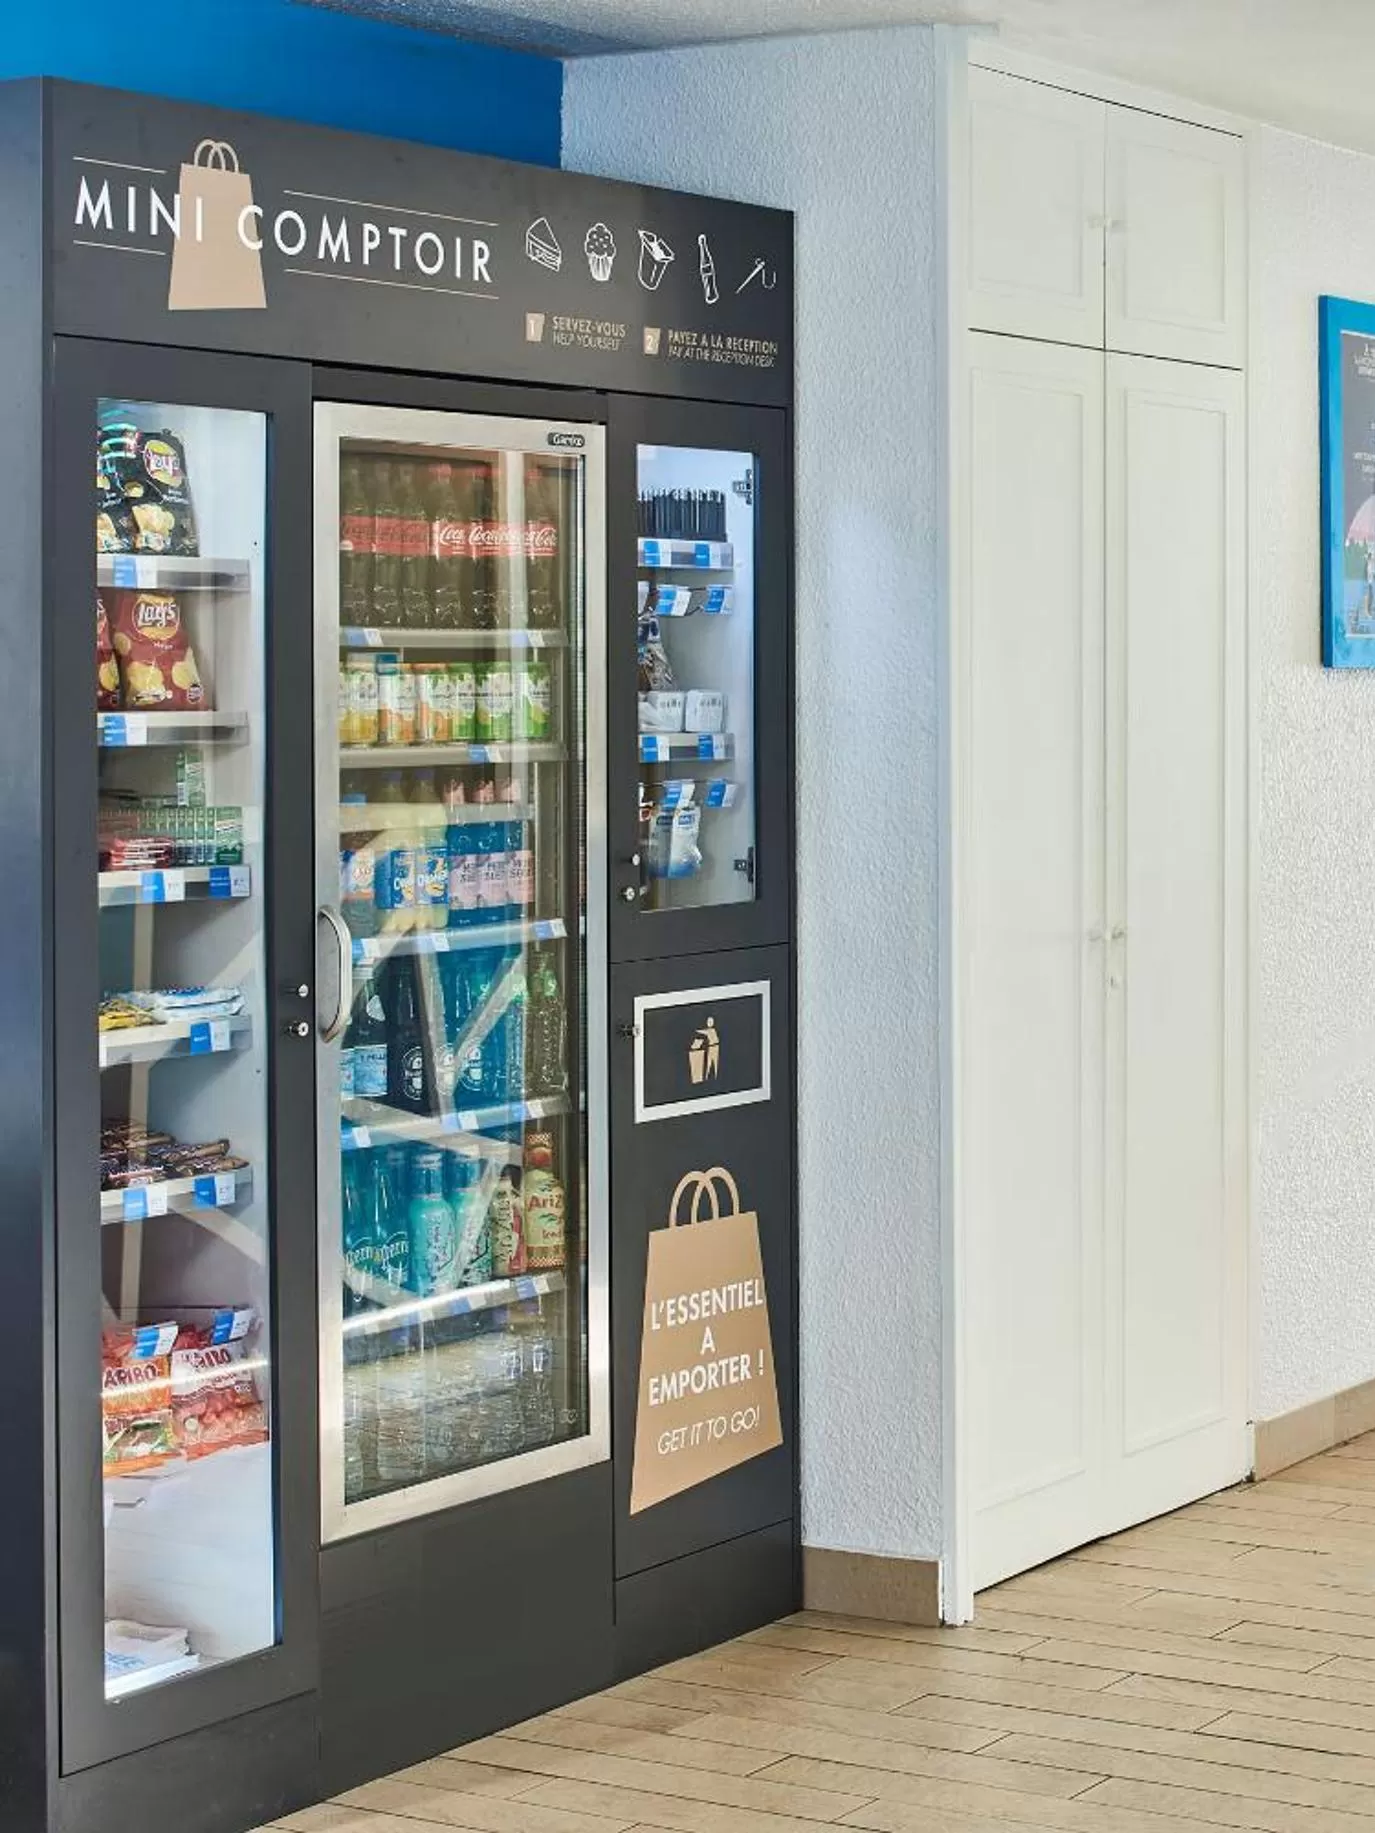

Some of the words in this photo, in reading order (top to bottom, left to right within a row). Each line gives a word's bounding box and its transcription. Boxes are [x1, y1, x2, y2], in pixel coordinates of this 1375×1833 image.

[74, 175, 203, 242] MINI
[237, 203, 494, 283] COMPTOIR
[552, 315, 626, 338] SERVEZ-VOUS
[668, 329, 697, 346] PAYEZ
[710, 334, 723, 349] LA
[651, 1279, 764, 1331] L'ESSENTIEL
[700, 1326, 716, 1355] A
[103, 1364, 157, 1389] ARIBO
[649, 1354, 752, 1406] EMPORTER
[758, 1349, 764, 1375] !
[658, 1424, 688, 1455] GET
[690, 1421, 703, 1446] IT
[706, 1416, 727, 1442] TO
[731, 1406, 760, 1433] GO!
